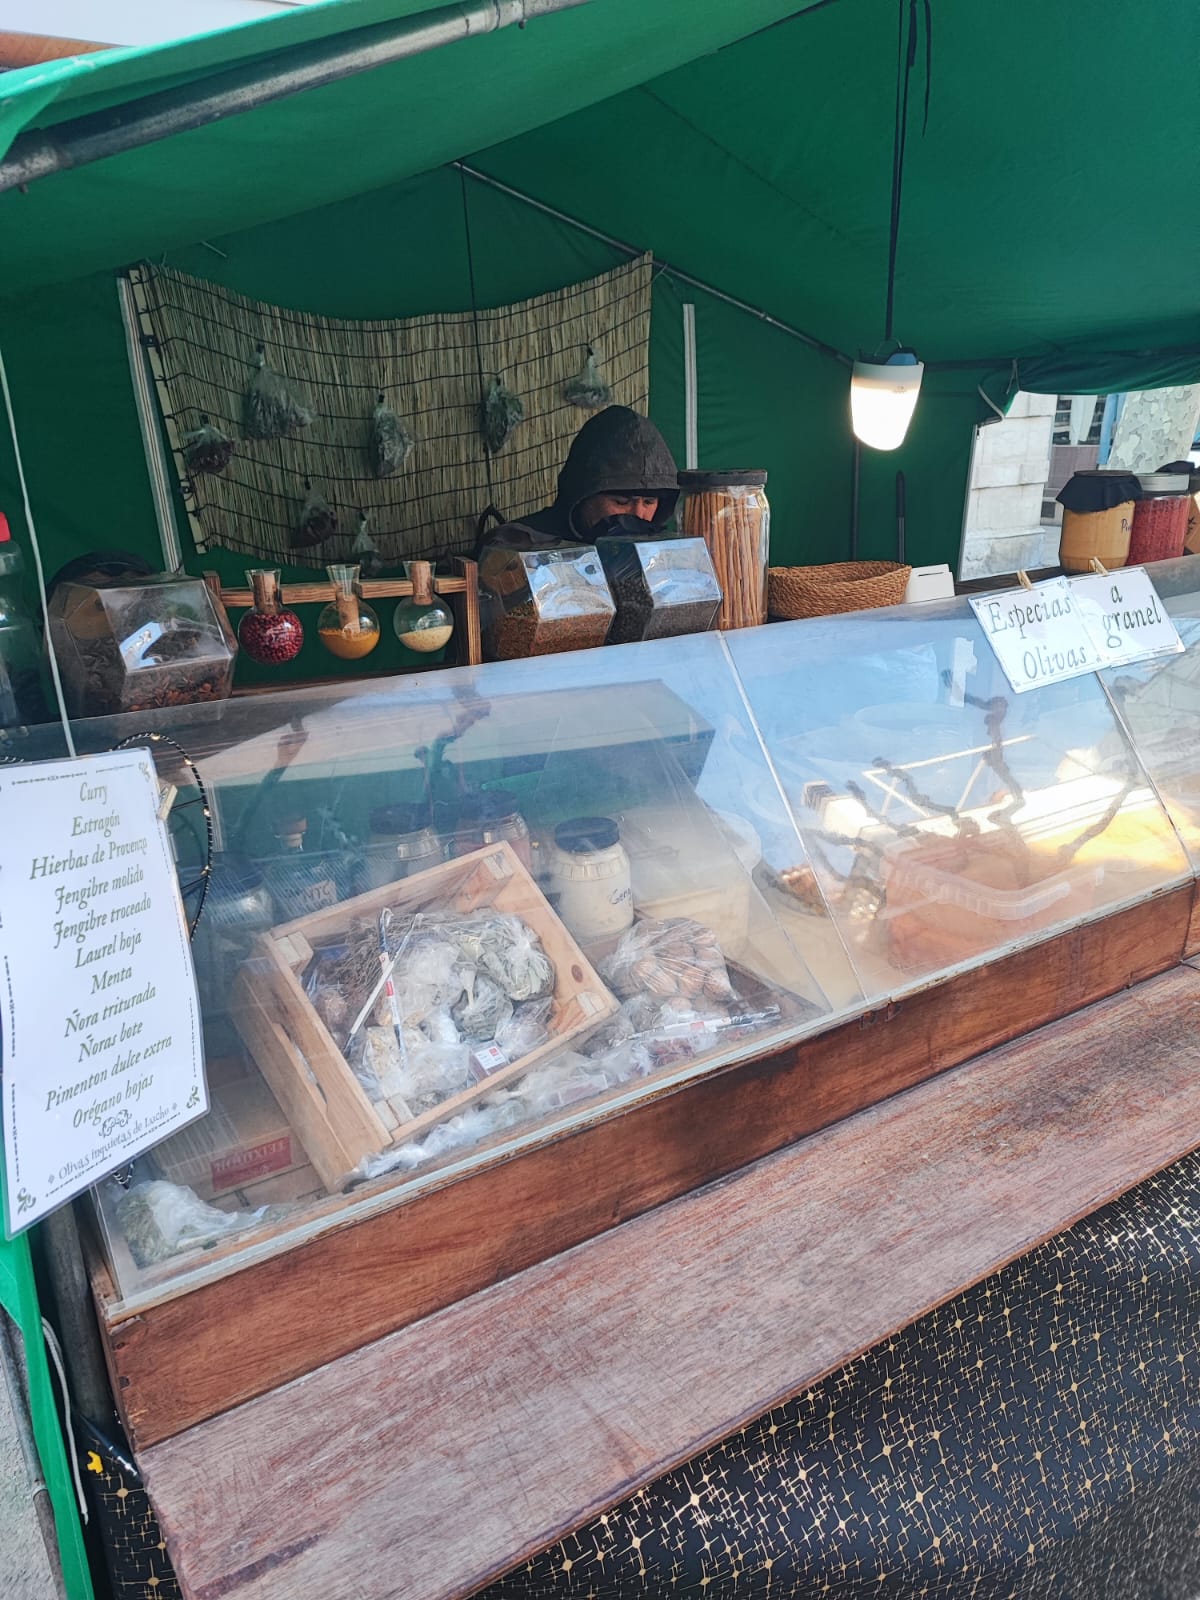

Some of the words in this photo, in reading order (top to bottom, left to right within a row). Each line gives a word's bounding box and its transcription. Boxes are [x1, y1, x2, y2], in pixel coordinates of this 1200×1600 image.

[1111, 585, 1123, 603] a
[987, 592, 1072, 639] Especias
[1102, 595, 1162, 648] granel
[1023, 645, 1086, 679] Olivas
[79, 781, 107, 805] Curry
[71, 809, 120, 837] Estragón
[30, 849, 88, 880] Hierbas
[91, 844, 105, 864] de
[112, 864, 144, 889] molido
[110, 892, 151, 923] troceado
[74, 935, 117, 968] Laurel
[119, 928, 142, 955] hoja
[90, 966, 133, 995] Menta
[64, 1008, 99, 1038] Ñora
[102, 982, 156, 1021] triturada
[78, 1033, 117, 1063] Ñoras
[120, 1021, 143, 1043] bote
[45, 1069, 107, 1112] Pimenton
[111, 1049, 141, 1077] dulce
[144, 1036, 172, 1060] extra
[73, 1091, 122, 1128] Orégano
[125, 1073, 154, 1101] hojas
[58, 1154, 90, 1179] Olivas
[133, 1120, 143, 1135] de
[145, 1105, 169, 1128] Lucho
